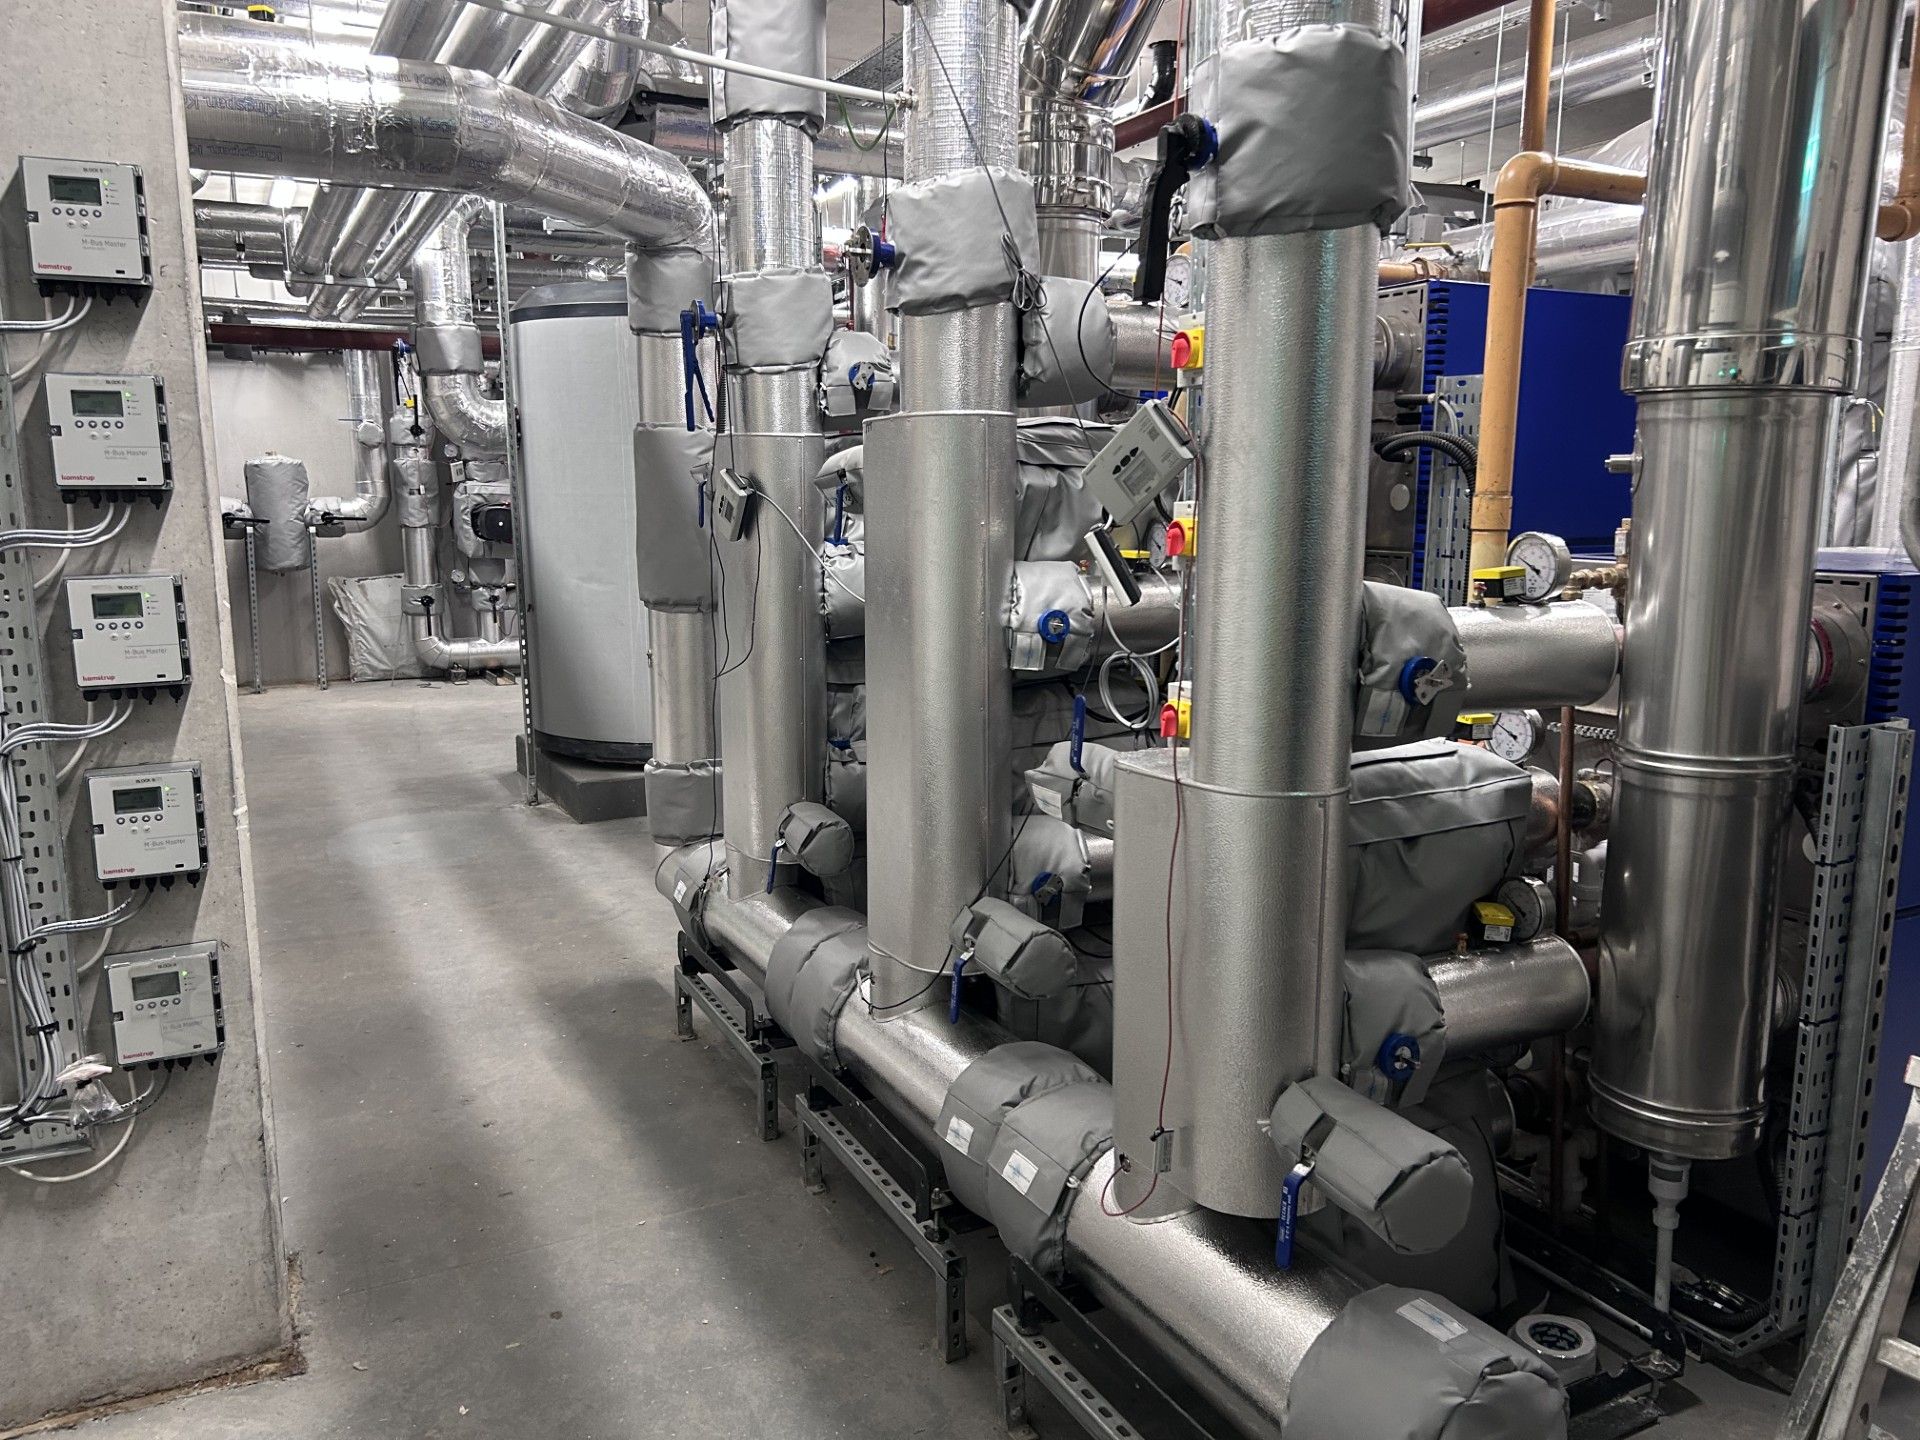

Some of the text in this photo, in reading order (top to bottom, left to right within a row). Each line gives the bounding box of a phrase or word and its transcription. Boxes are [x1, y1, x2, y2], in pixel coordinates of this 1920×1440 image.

[82, 239, 103, 247] M-Bus
[104, 240, 127, 248] Master
[38, 262, 72, 271] kamstrup
[144, 838, 187, 848] M-Bus Master
[103, 867, 135, 875] kamstrup
[122, 1050, 154, 1060] kamstrup
